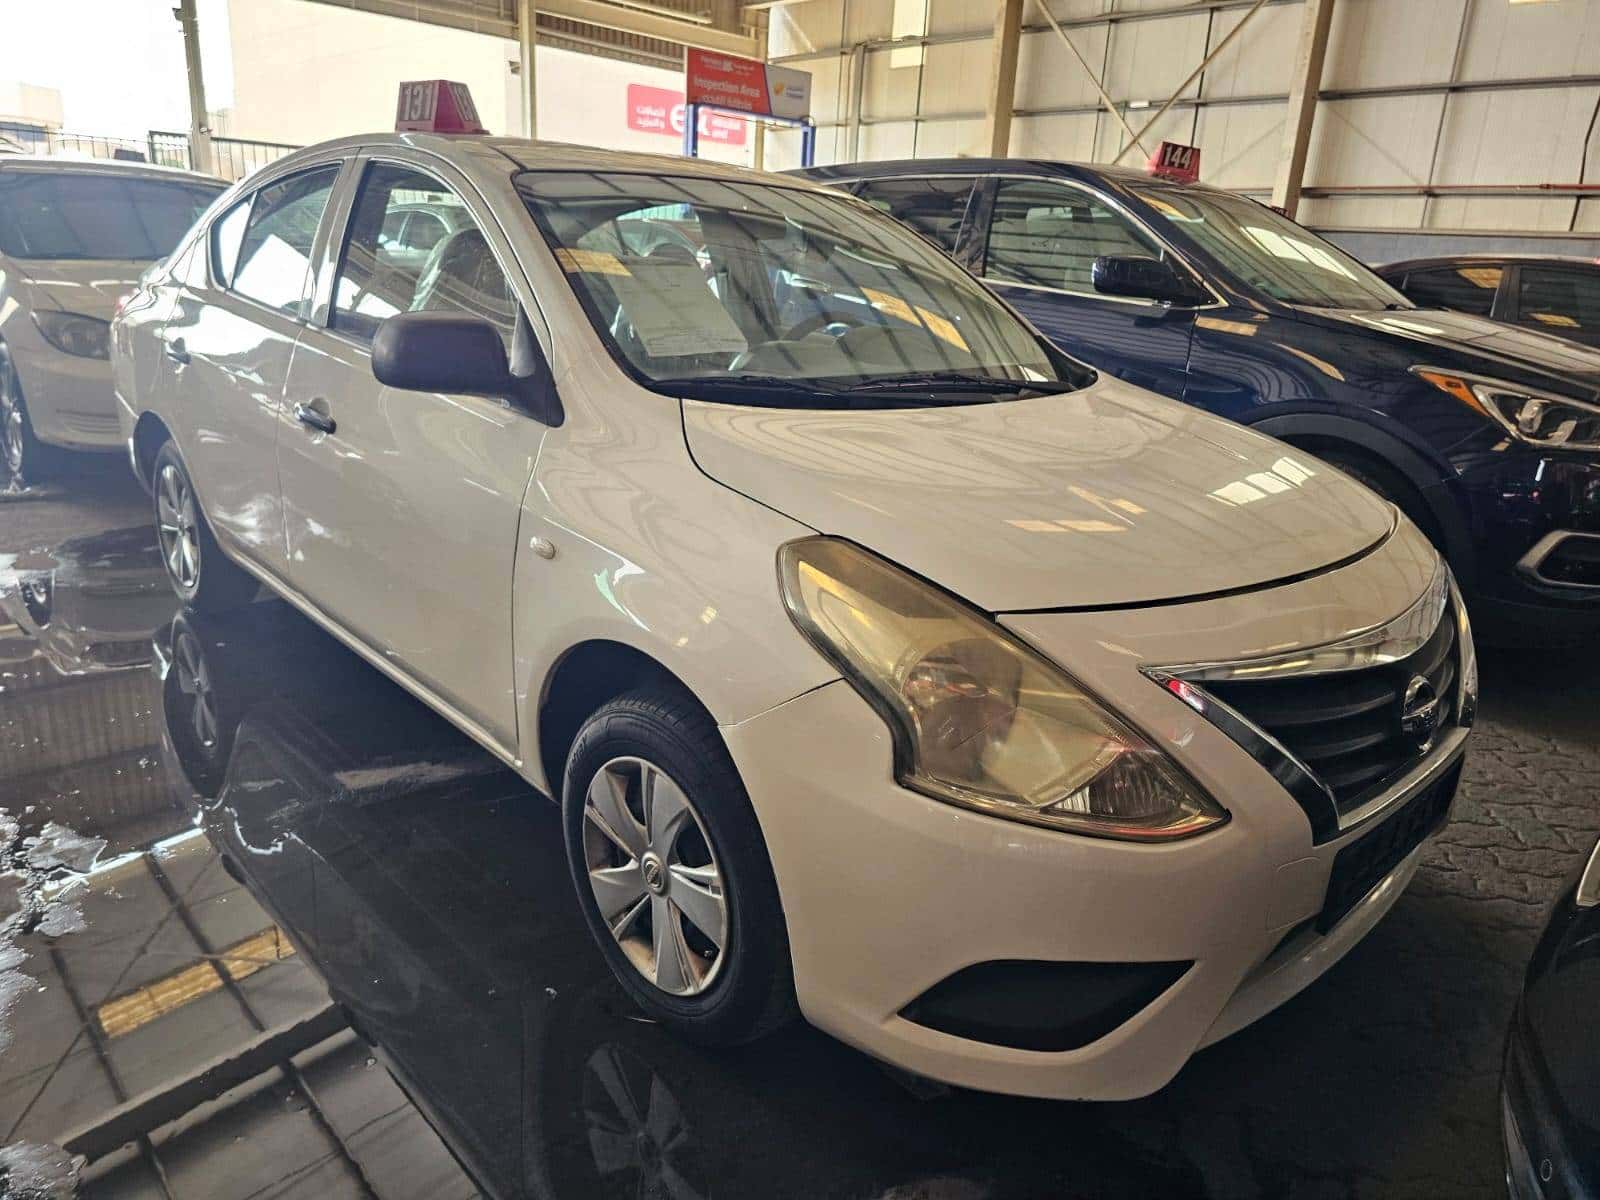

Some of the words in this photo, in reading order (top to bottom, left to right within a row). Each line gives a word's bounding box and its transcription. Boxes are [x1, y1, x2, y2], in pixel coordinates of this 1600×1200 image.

[403, 83, 433, 120] 131
[740, 84, 761, 98] Area
[1164, 144, 1193, 169] 144
